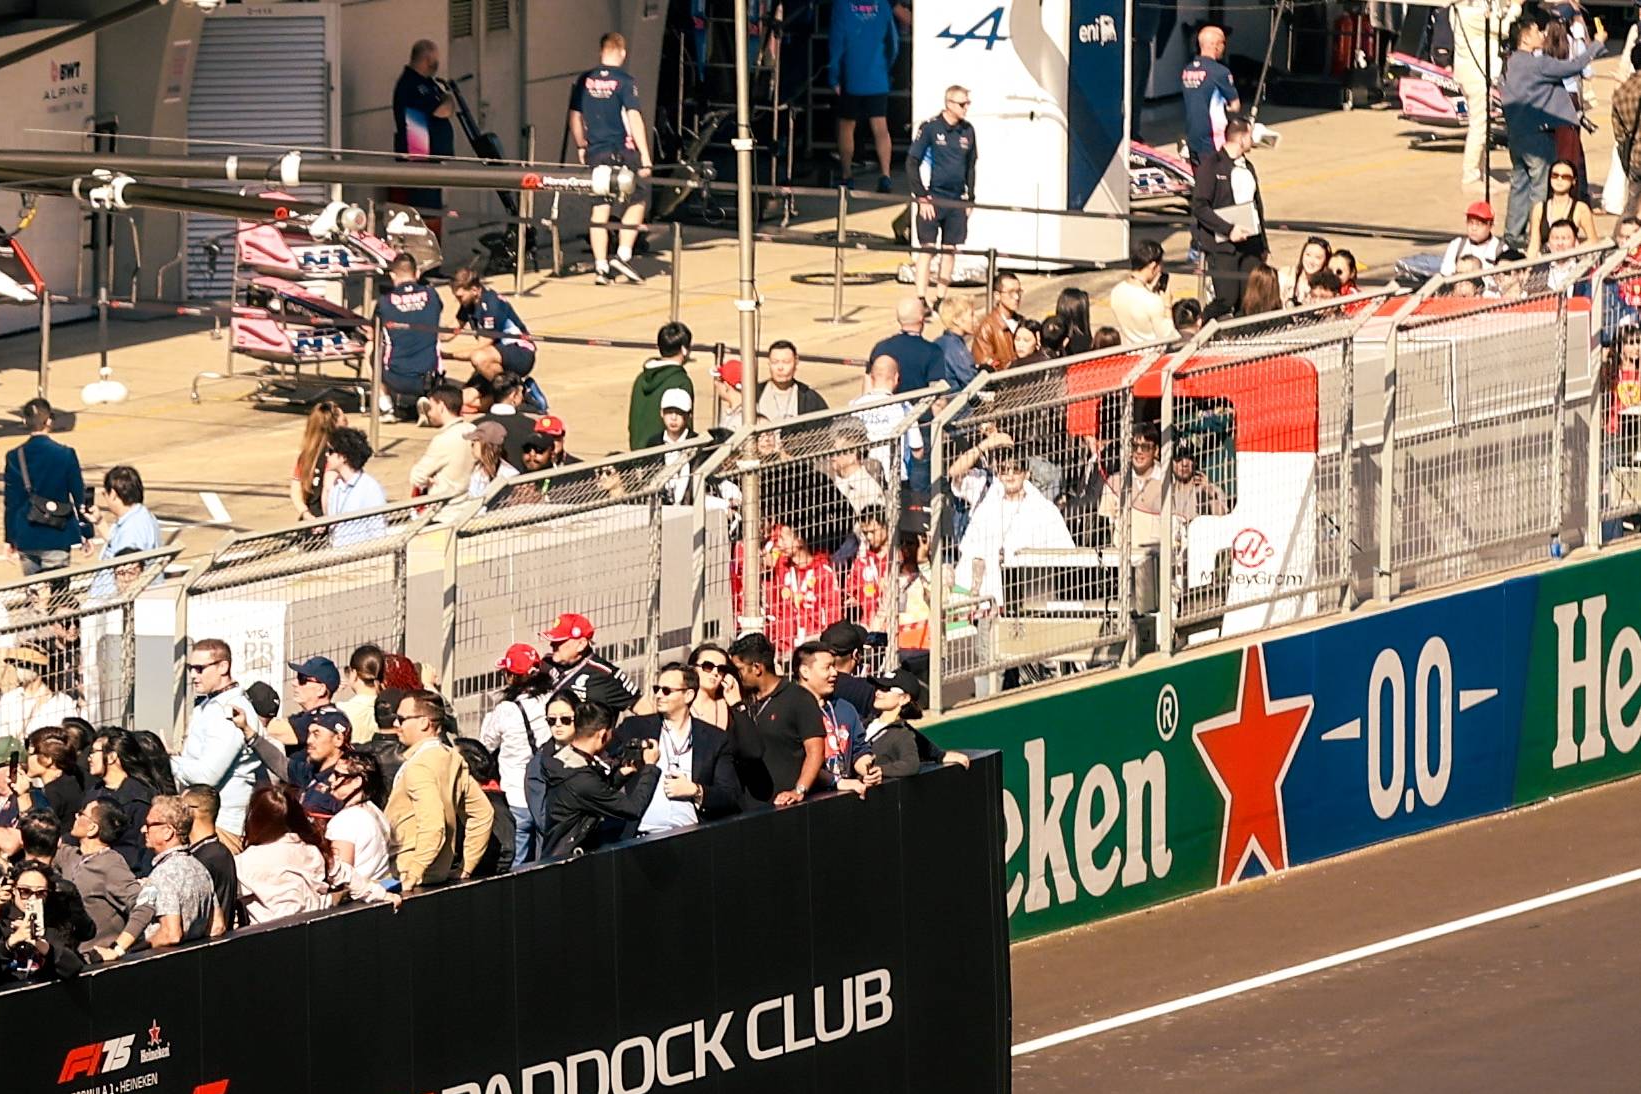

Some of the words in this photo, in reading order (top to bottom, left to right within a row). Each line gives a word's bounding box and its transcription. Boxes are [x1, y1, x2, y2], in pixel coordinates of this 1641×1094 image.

[43, 83, 88, 100] ALPINE
[1368, 636, 1453, 820] 0.0
[746, 968, 893, 1062] CLUB
[119, 1071, 159, 1094] HEINEKEN
